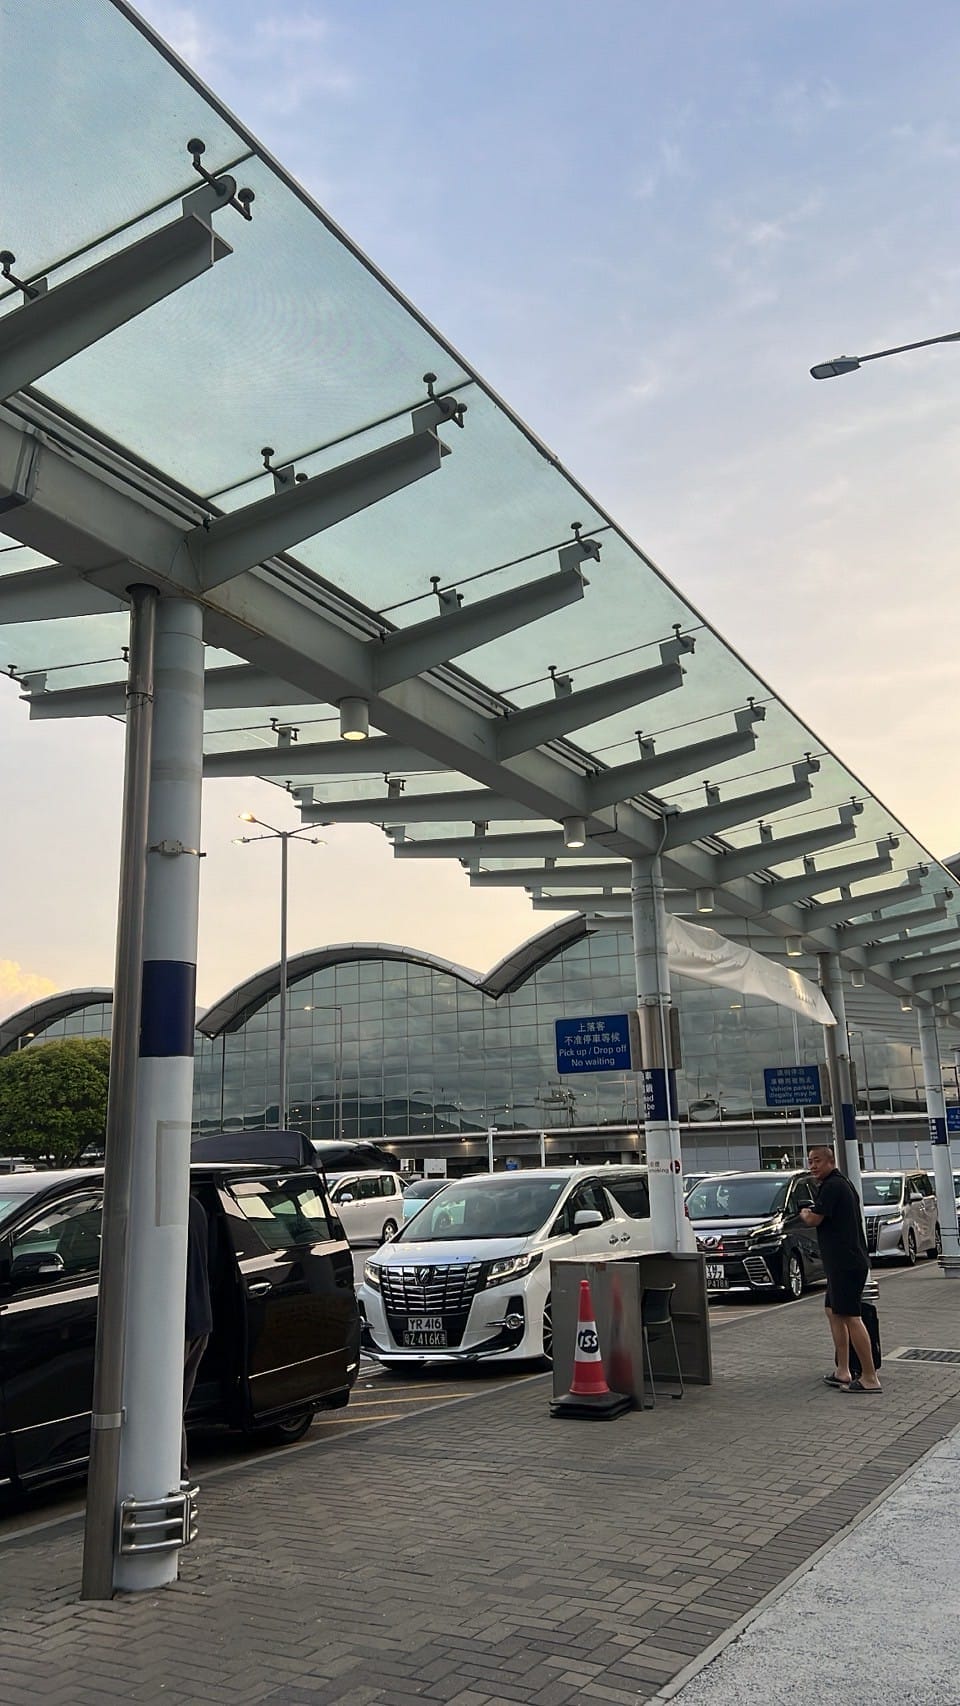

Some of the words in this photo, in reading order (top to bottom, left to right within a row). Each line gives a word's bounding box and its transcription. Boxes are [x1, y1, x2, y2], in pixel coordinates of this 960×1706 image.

[578, 1021, 606, 1032] 上落客
[564, 1032, 620, 1045] 不准停車等候
[559, 1048, 575, 1057] Pick
[576, 1049, 587, 1057] up
[593, 1046, 614, 1055] Drop
[615, 1044, 627, 1053] off
[571, 1058, 583, 1067] No
[584, 1056, 615, 1067] waiting
[410, 1319, 423, 1329] YR
[424, 1318, 441, 1329] 416
[580, 1335, 597, 1348] ISS
